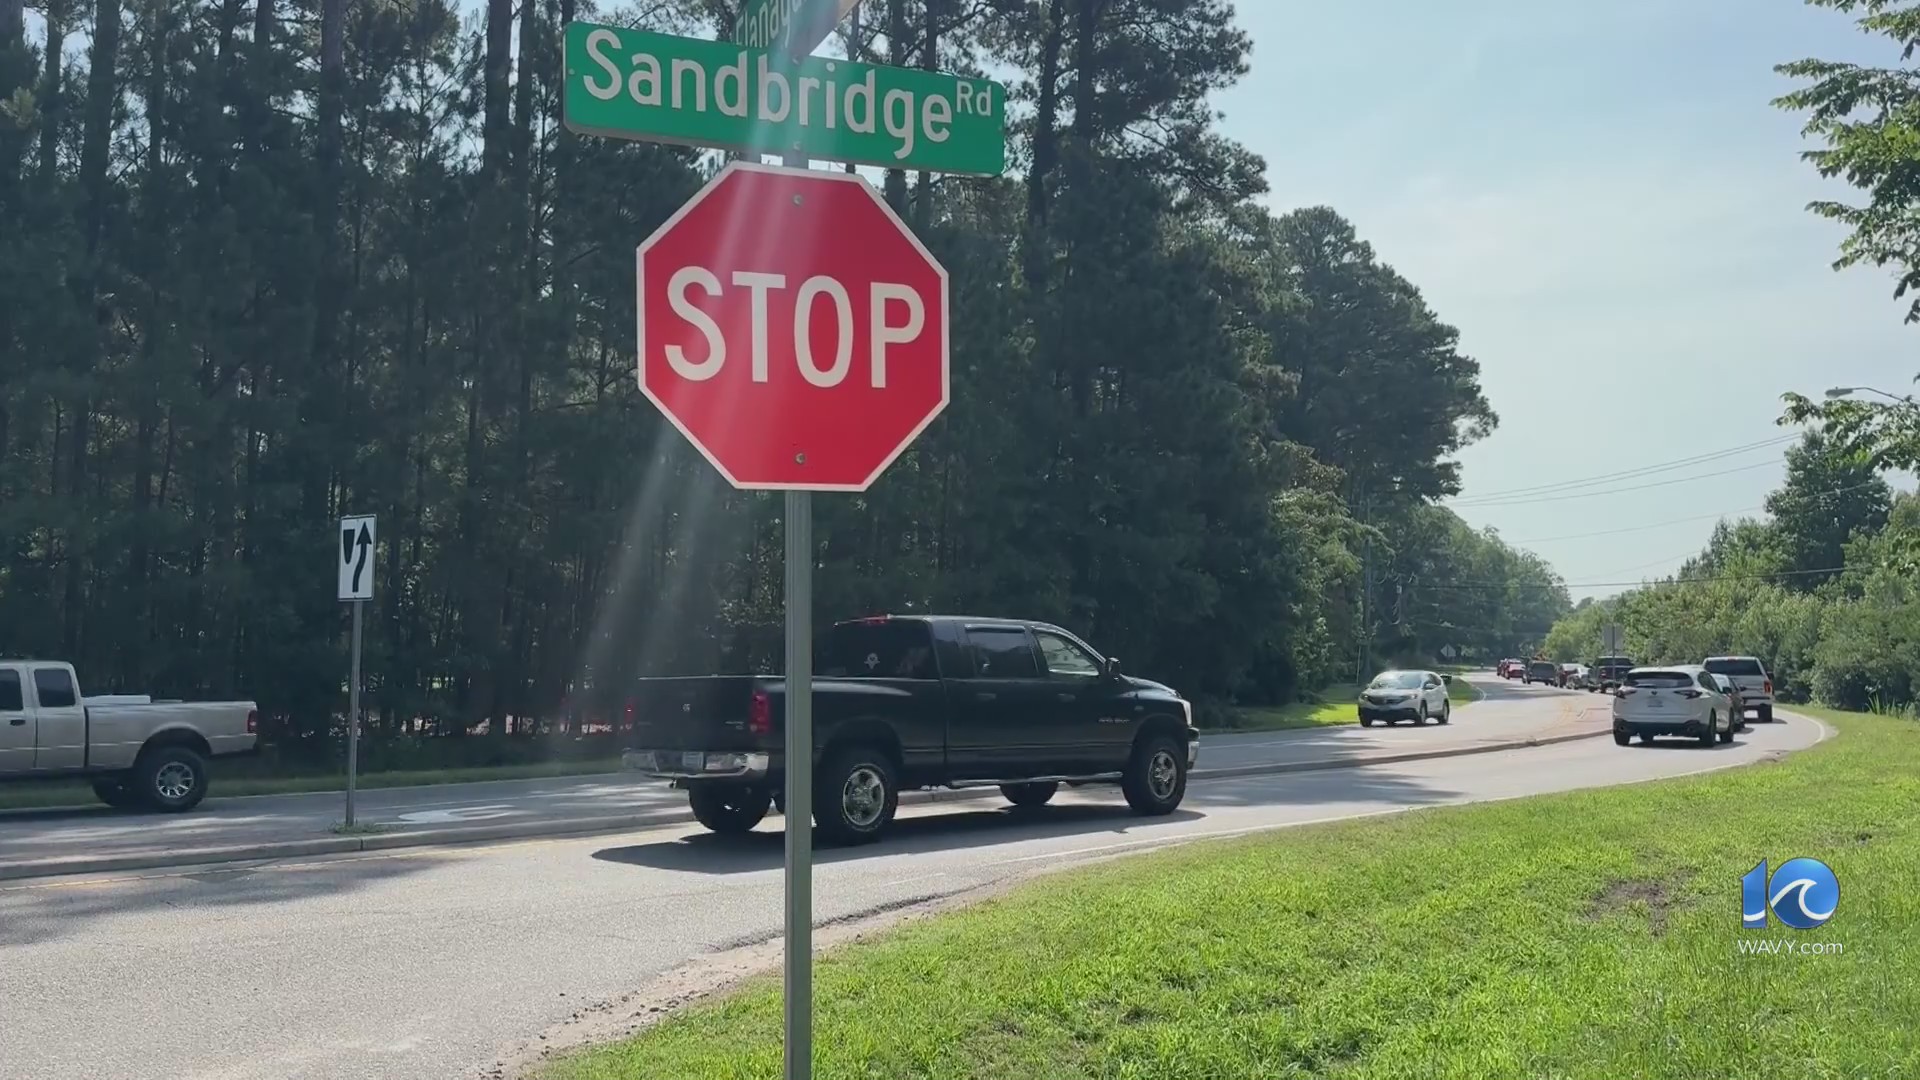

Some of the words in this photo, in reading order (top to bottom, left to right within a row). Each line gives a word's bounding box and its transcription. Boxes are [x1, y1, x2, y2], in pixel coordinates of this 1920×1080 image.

[583, 29, 952, 159] Sandbridge
[956, 80, 992, 117] Rd
[664, 265, 925, 389] STOP
